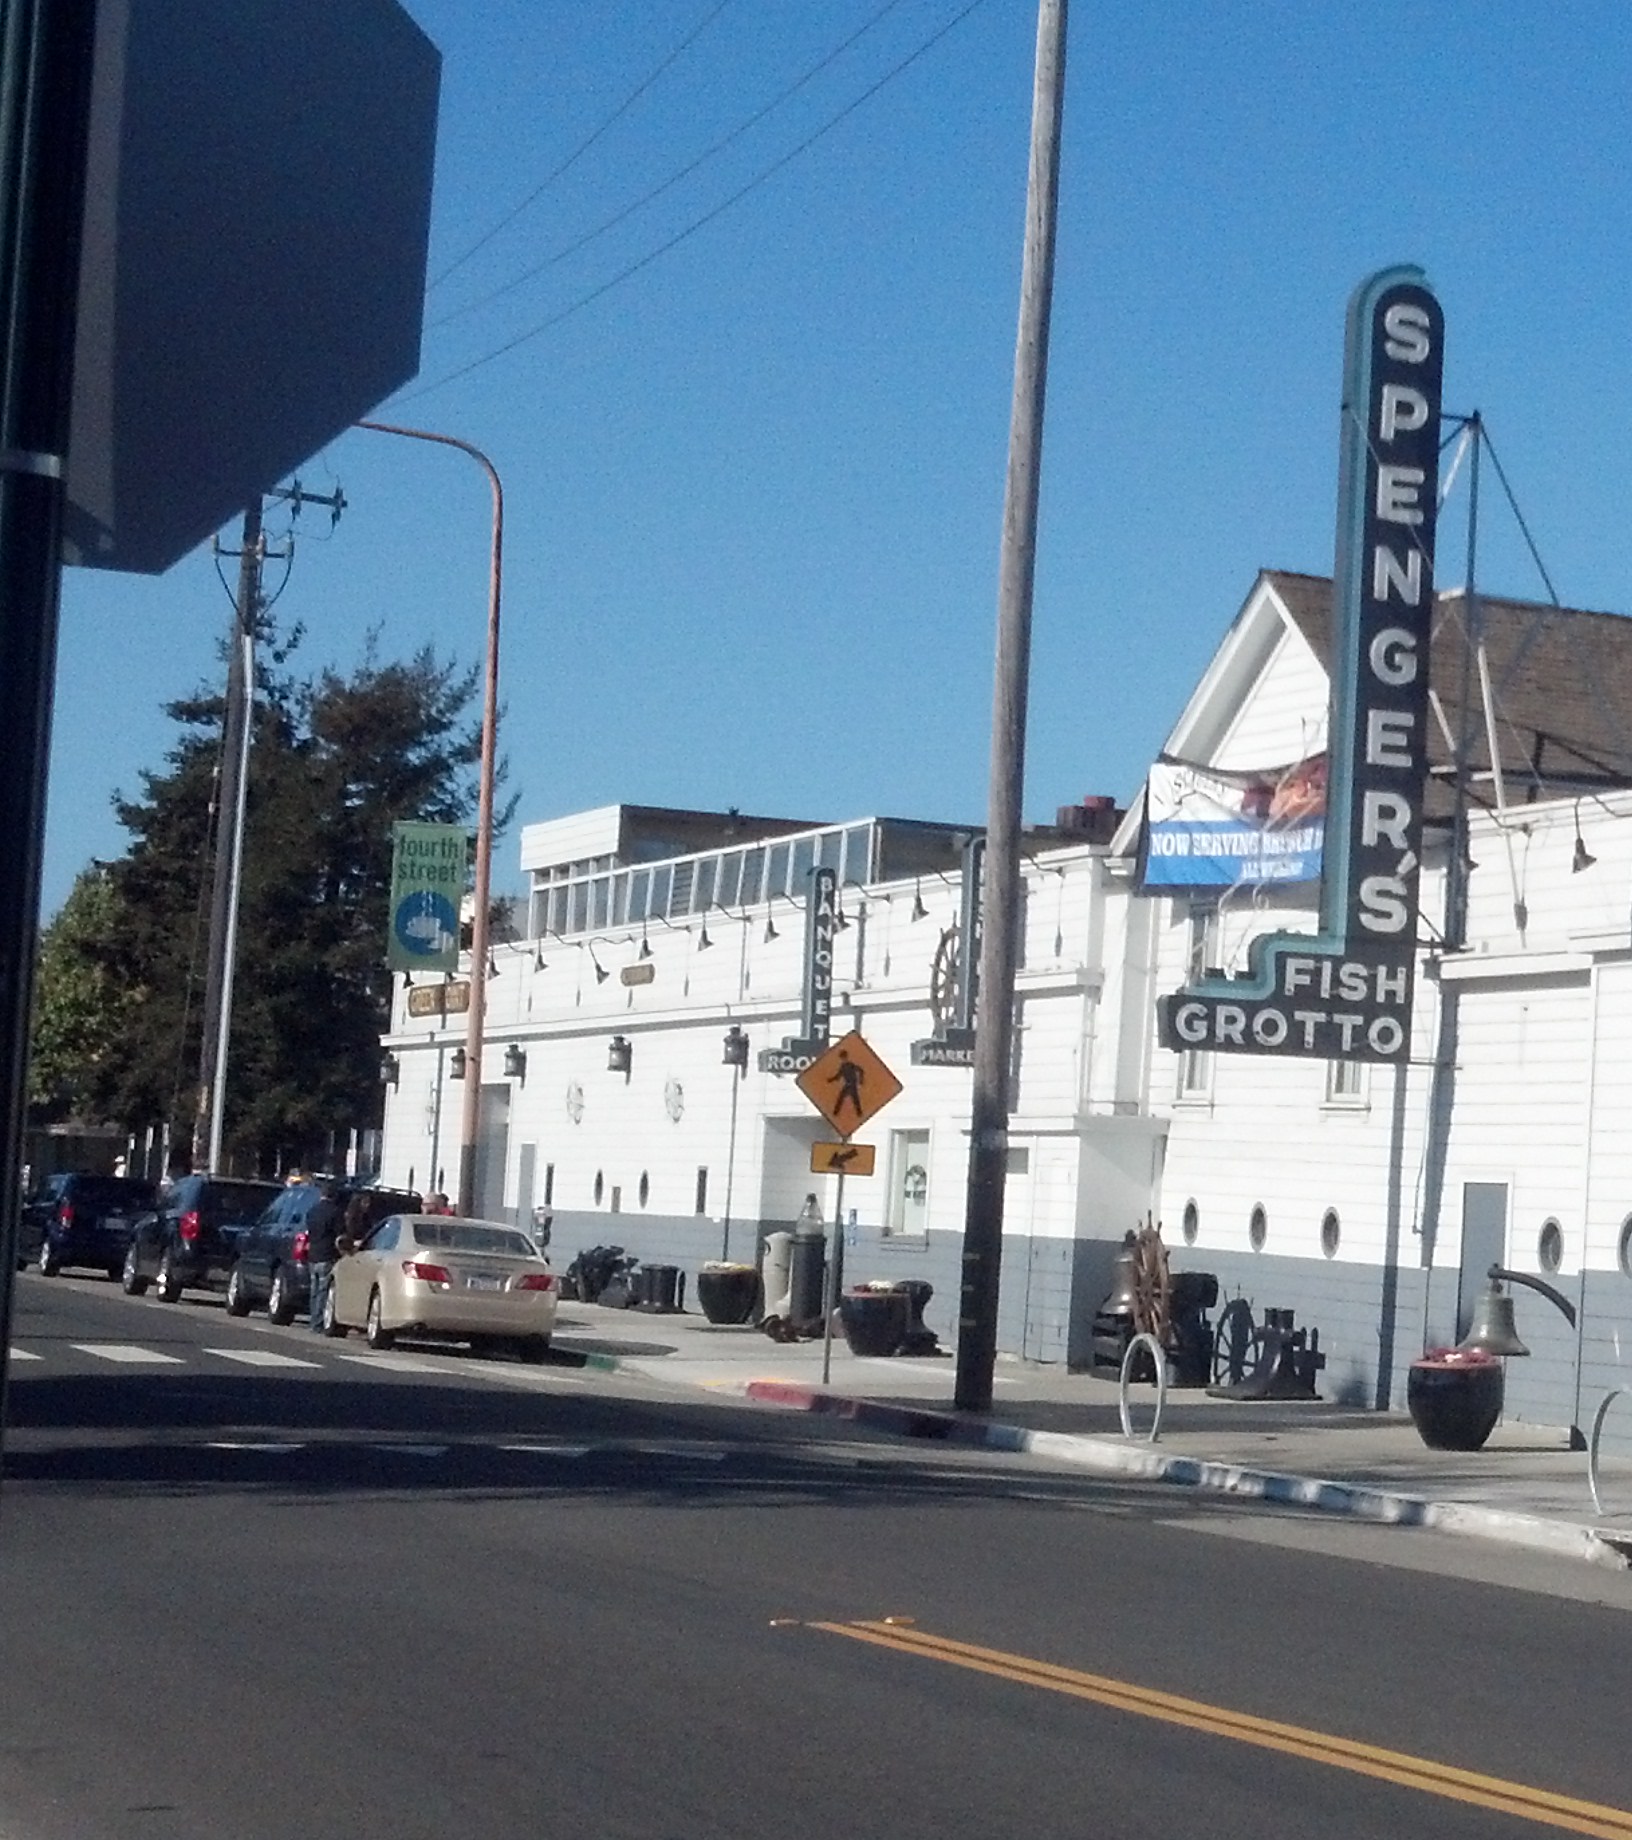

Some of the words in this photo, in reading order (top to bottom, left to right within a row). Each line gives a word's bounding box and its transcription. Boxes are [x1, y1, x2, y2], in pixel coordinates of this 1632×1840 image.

[1359, 303, 1430, 934] SPENGER'S
[398, 834, 459, 859] fourth
[1151, 833, 1191, 857] NOW
[1193, 832, 1260, 856] SERVING
[398, 860, 457, 883] street
[814, 876, 834, 1040] BANQUET
[1284, 957, 1407, 1005] FISH
[1175, 1003, 1405, 1056] GROTTO
[767, 1055, 817, 1071] ROO
[920, 1048, 975, 1063] MARKE
